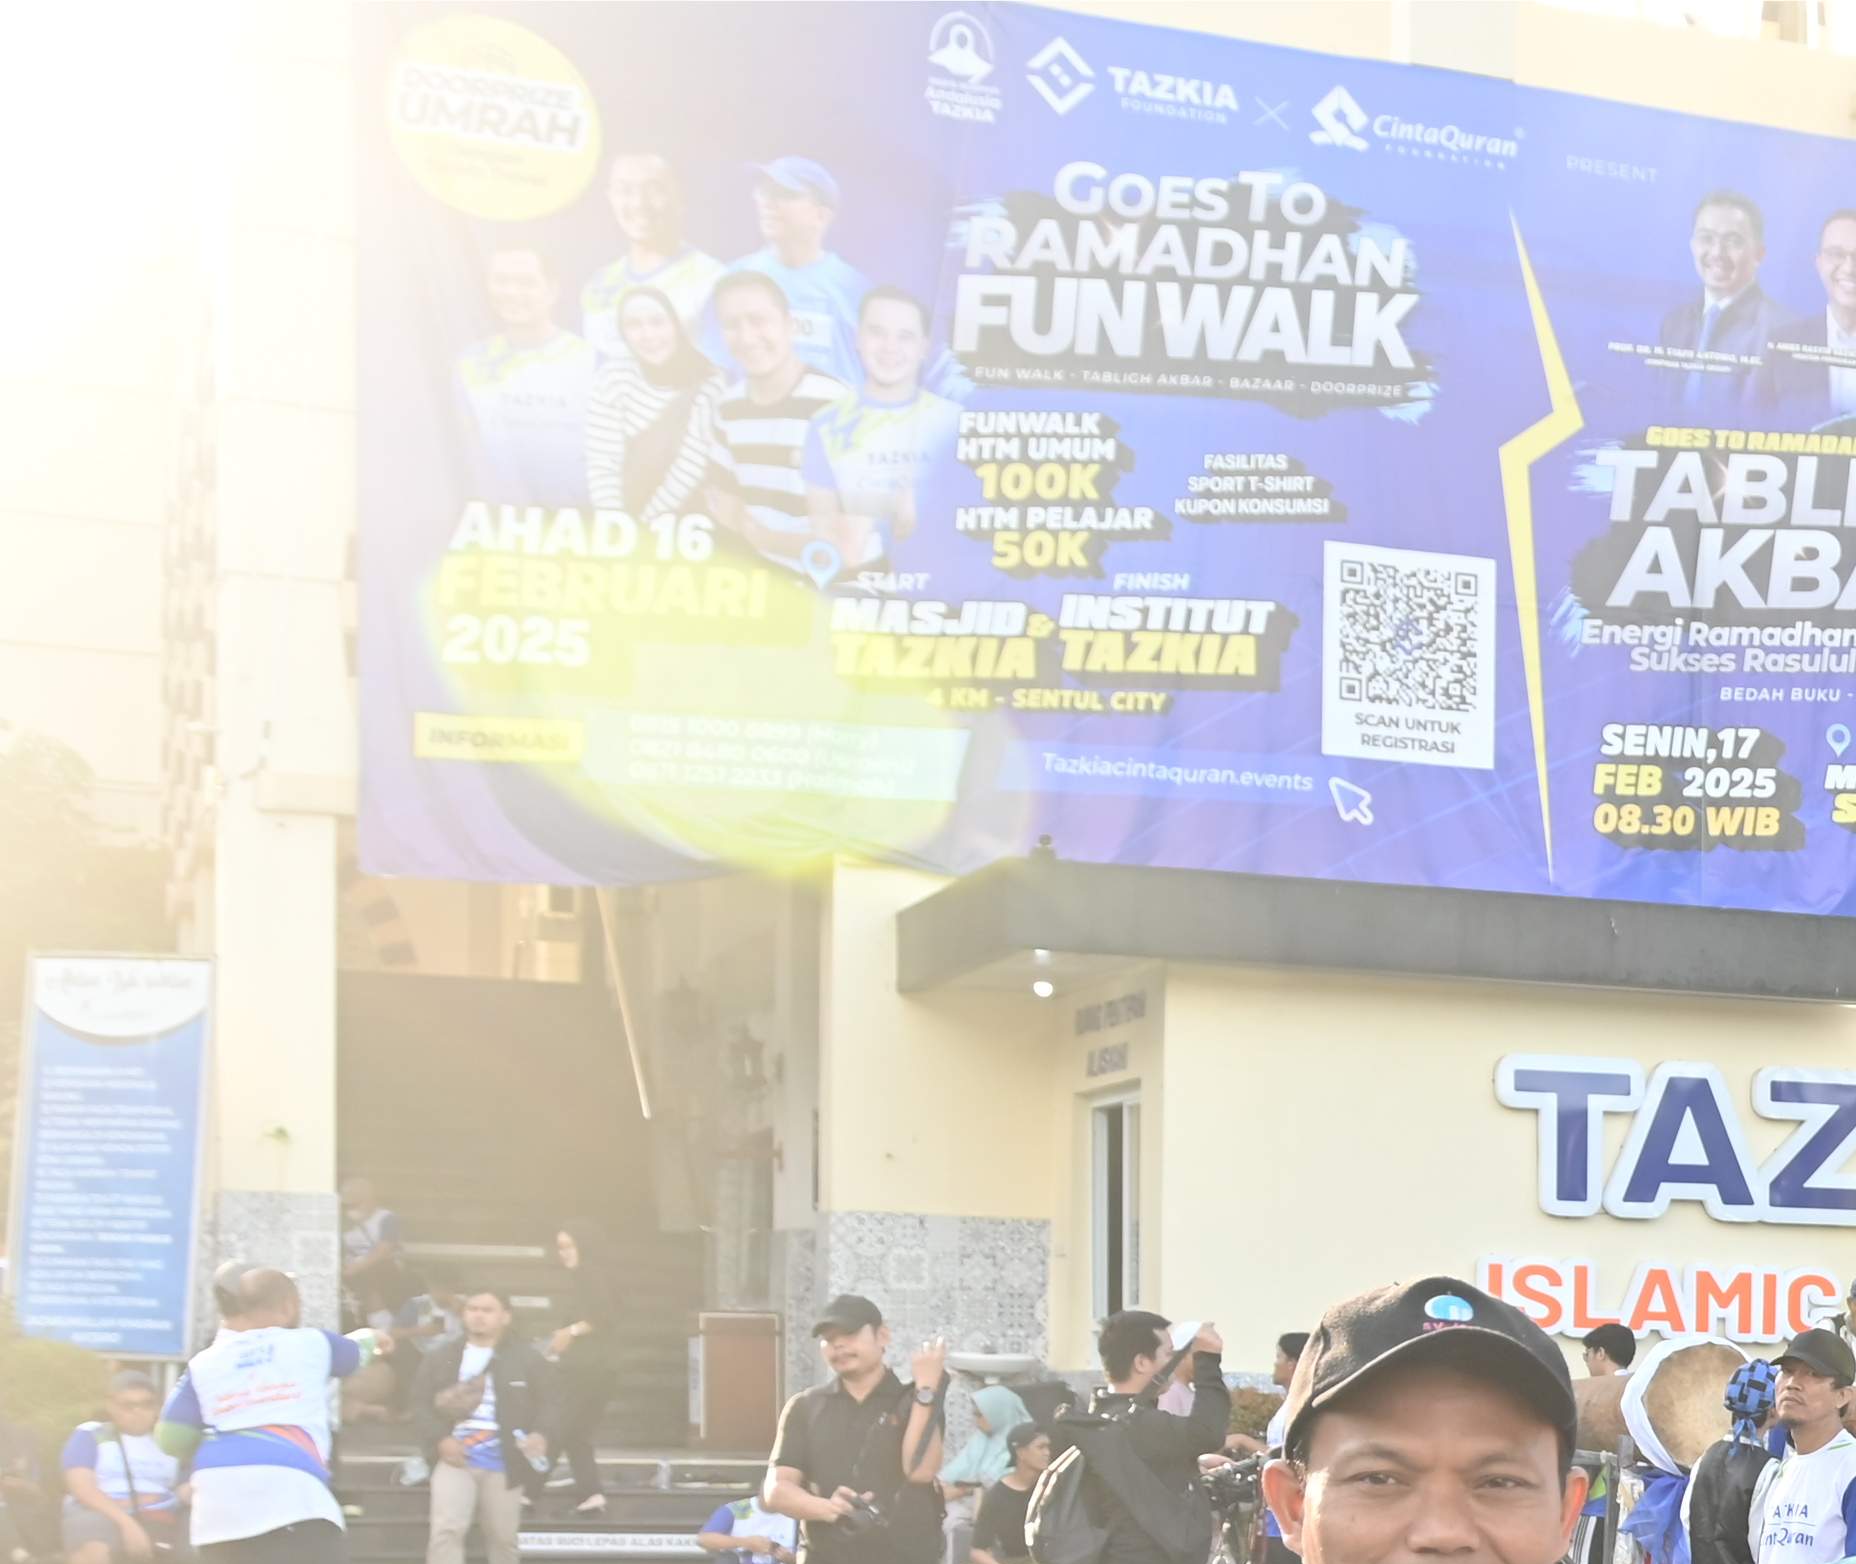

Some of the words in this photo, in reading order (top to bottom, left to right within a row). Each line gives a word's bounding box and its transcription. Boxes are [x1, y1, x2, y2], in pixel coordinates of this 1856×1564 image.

[402, 65, 574, 110] DOORPRIZE
[1107, 65, 1239, 112] TAZKIA
[400, 92, 581, 148] UMRAH
[930, 99, 996, 124] TAZKIA
[1119, 97, 1229, 125] FOUNDATION
[1371, 114, 1519, 159] CintaQuran
[1565, 153, 1659, 183] PRESENT
[963, 214, 1407, 288] RAMADHAN
[952, 273, 1147, 357] FUN
[1155, 283, 1421, 369] WALK
[974, 365, 1009, 381] FUN
[1016, 367, 1064, 383] WALK
[1081, 369, 1153, 386] TABLIGH
[1157, 372, 1213, 388] AKBAR
[1229, 376, 1298, 391] BAZAAR
[1309, 380, 1402, 397] DOORPRIZE
[959, 410, 1101, 436] FUNWALK
[1645, 425, 1711, 449] GOES
[1714, 429, 1746, 450] TO
[955, 436, 1022, 461] HTM
[1026, 438, 1117, 463] UMUM
[1203, 453, 1288, 471] FASILITAS
[974, 461, 1101, 500] 100K
[1187, 475, 1246, 493] SPORT
[1248, 475, 1315, 493] T-SHIRT
[955, 506, 1021, 531] HTM
[1025, 507, 1154, 531] PELAJAR
[1174, 496, 1236, 515] KUPON
[1237, 497, 1331, 517] KONSUMSI
[448, 501, 637, 559] AHAD
[648, 513, 714, 561] 16
[990, 530, 1090, 569] 50K
[436, 553, 769, 620] FEBRUARI
[1113, 571, 1190, 592] FINISH
[829, 596, 1027, 637] MASJID
[1059, 593, 1276, 636] INSTITUT
[440, 613, 593, 667] 2025
[1582, 618, 1683, 651] Energi
[830, 633, 1037, 680] TAZKIA
[1058, 630, 1258, 677] TAZKIA
[1629, 645, 1740, 674] Sukses
[951, 688, 991, 709] KM
[1011, 688, 1106, 712] SENTUL
[1110, 691, 1168, 713] CITY
[1719, 687, 1785, 703] BEDAH
[1790, 688, 1842, 704] BUKU
[428, 726, 571, 754] INFORMASI
[1353, 711, 1401, 730] SCAN
[1404, 717, 1462, 735] UNTUK
[1359, 733, 1456, 755] REGISTRASI
[1041, 751, 1315, 793] Tazkiacintaquran.events
[1592, 763, 1663, 797] FEB
[1681, 767, 1777, 799] 2025
[1593, 803, 1696, 837] 08.30
[1705, 806, 1781, 838] WIB
[1486, 1262, 1838, 1336] ISLAMIC
